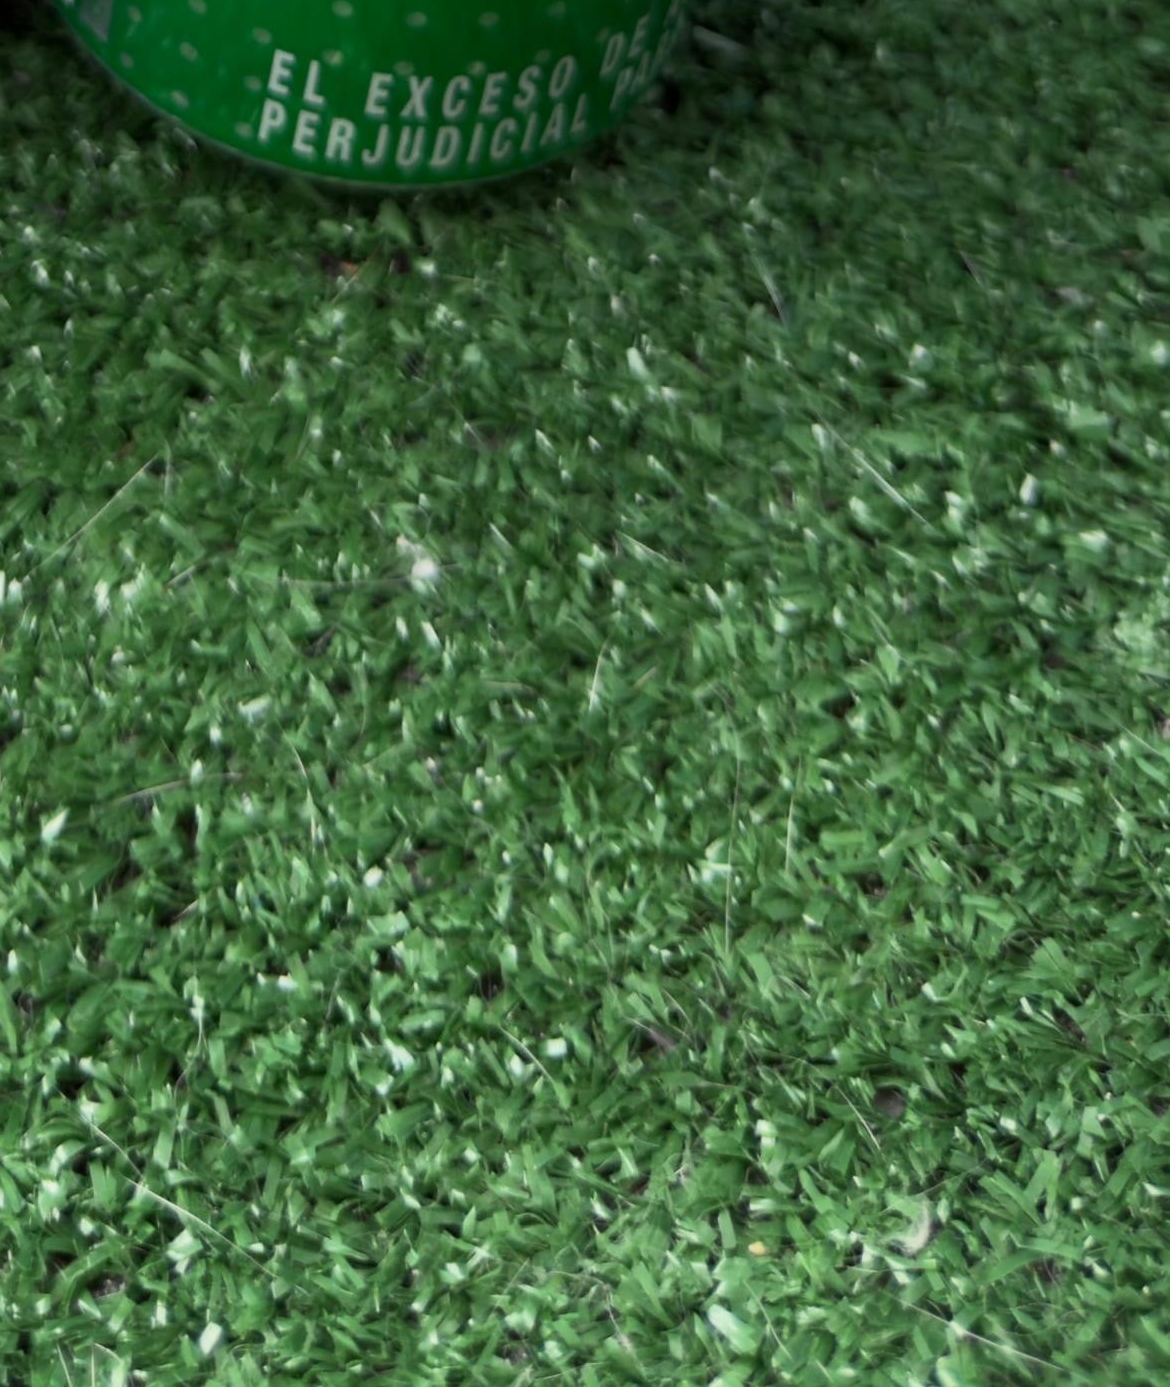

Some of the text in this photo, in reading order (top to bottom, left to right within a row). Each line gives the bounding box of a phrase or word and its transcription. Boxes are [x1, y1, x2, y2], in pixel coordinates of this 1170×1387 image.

[266, 12, 653, 119] EL EXCESO DE
[257, 93, 588, 167] PERJUDICIAL
